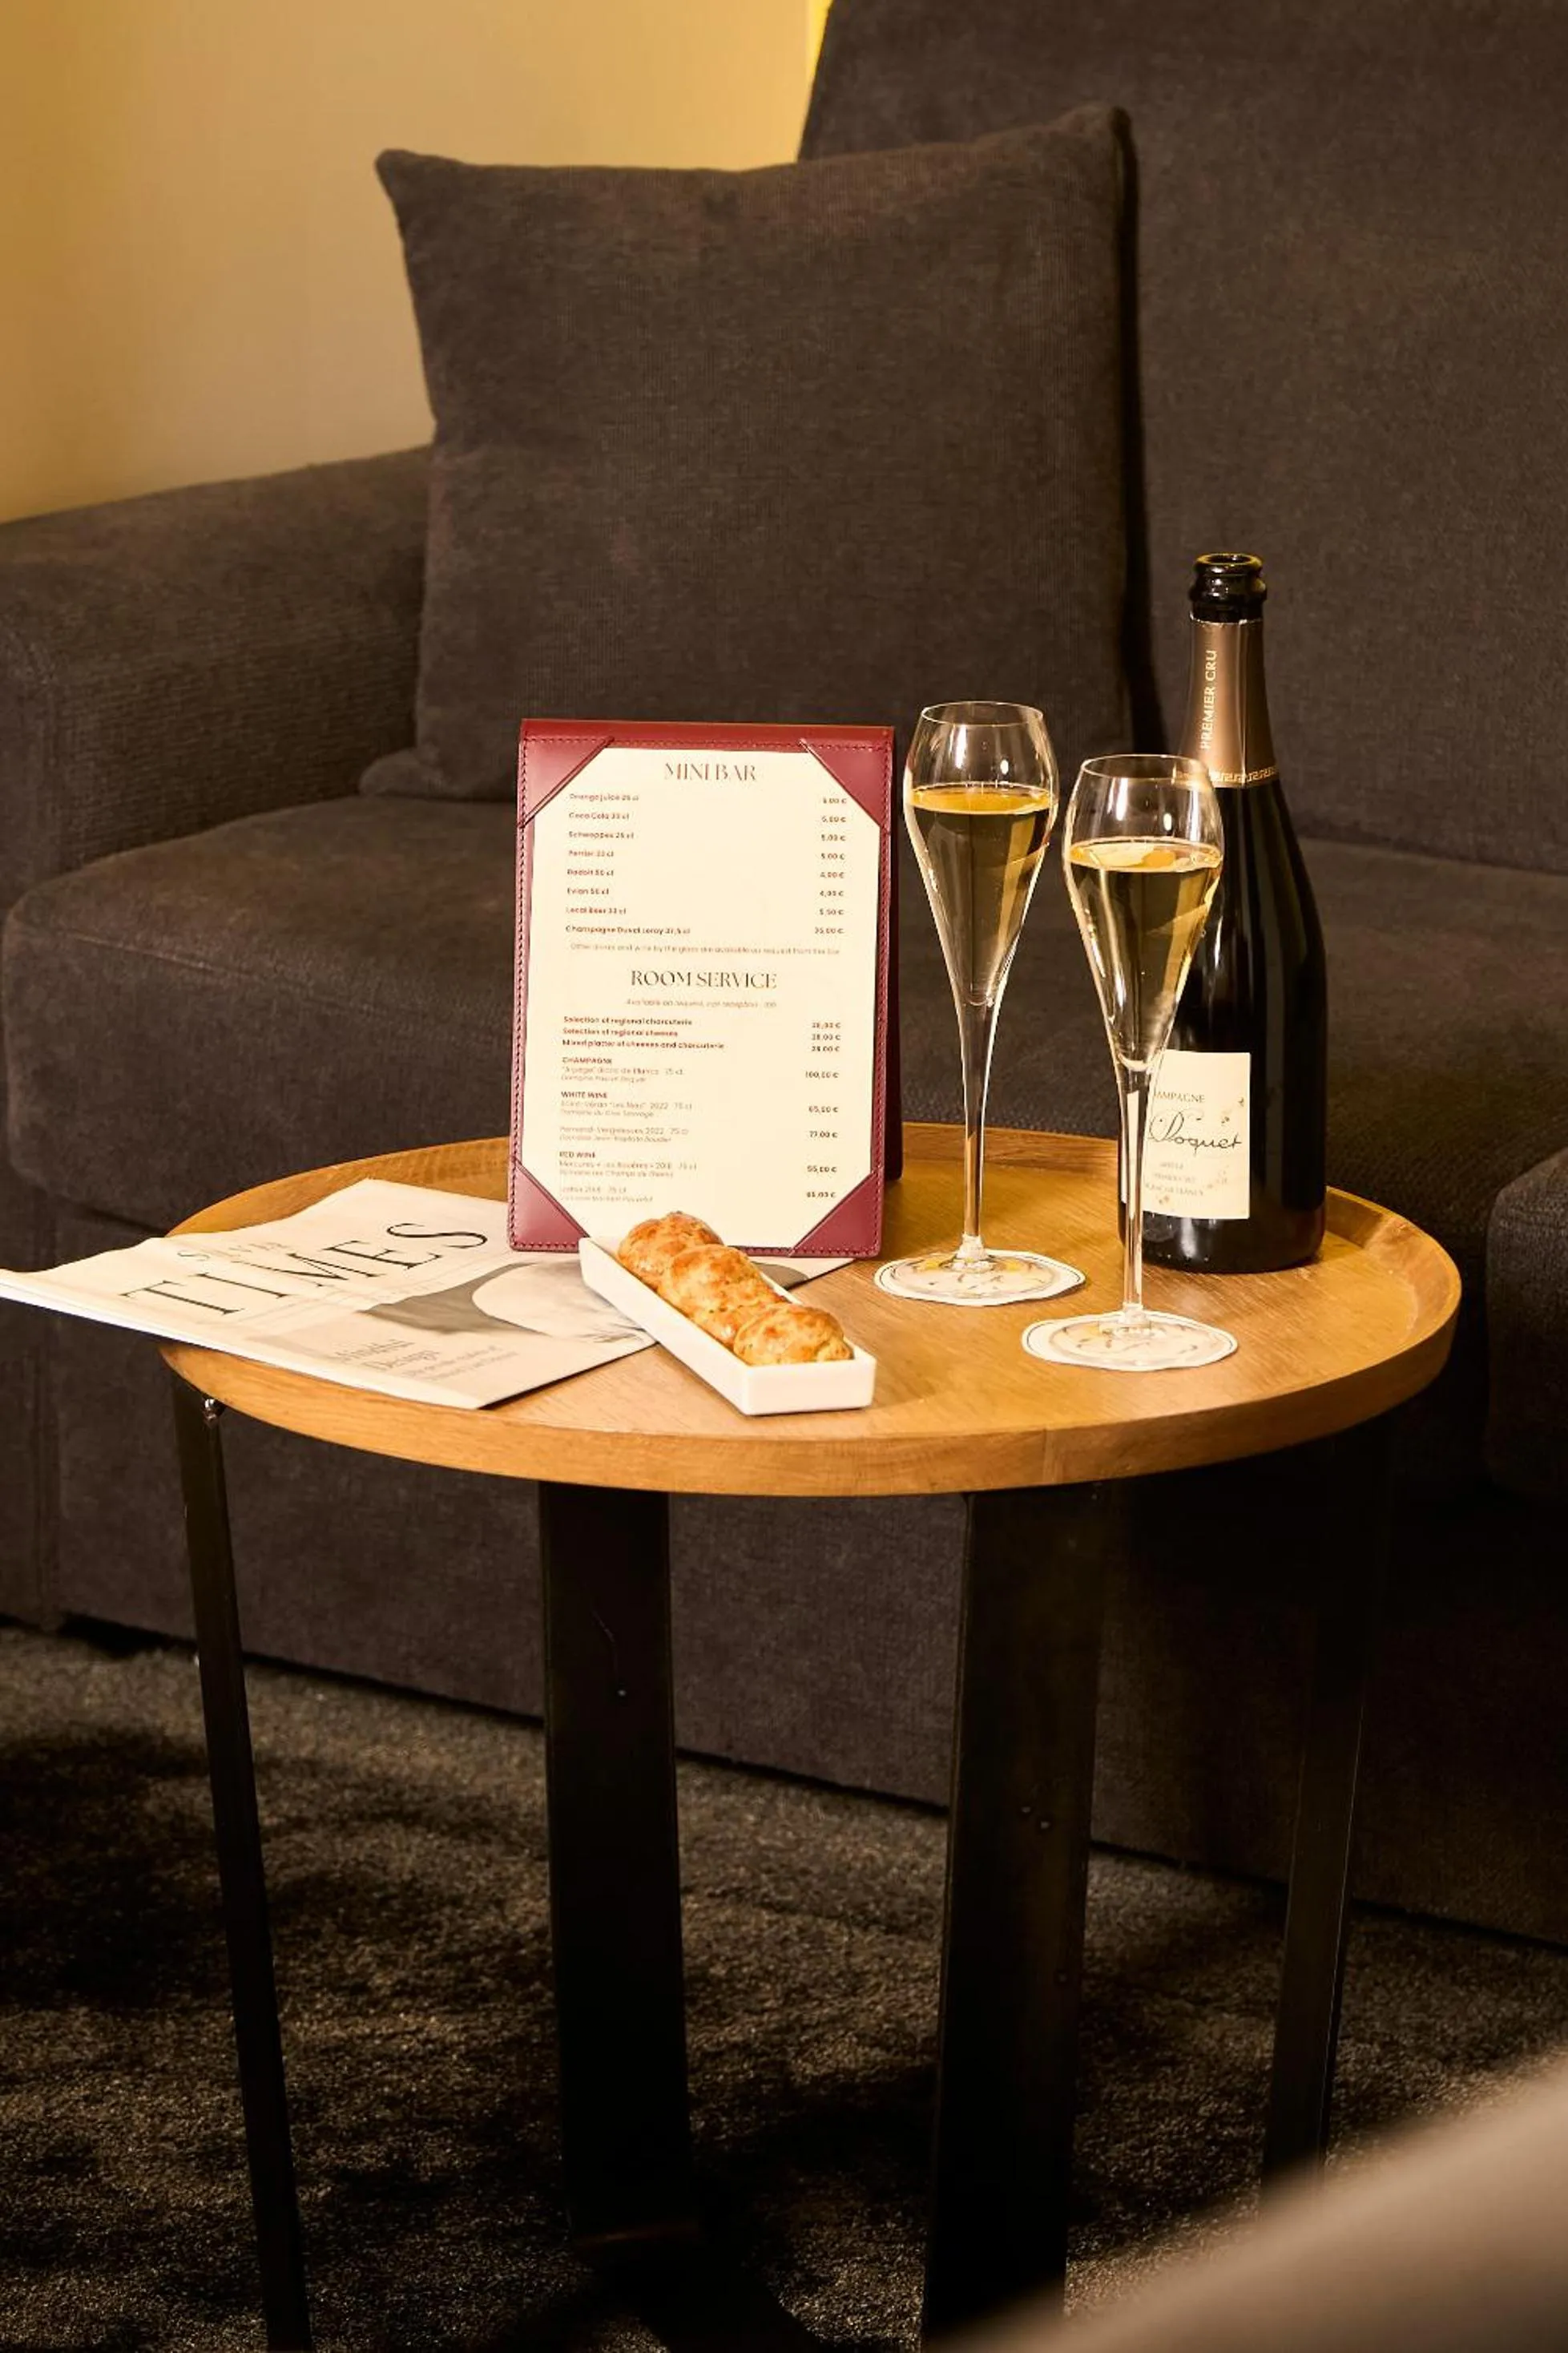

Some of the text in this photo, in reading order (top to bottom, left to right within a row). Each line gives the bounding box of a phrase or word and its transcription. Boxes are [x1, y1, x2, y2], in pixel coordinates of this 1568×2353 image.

[1200, 650, 1217, 749] PREMIER CRU
[665, 763, 756, 781] MINI BAR
[566, 926, 615, 934] Champagne
[631, 970, 777, 988] ROOM SERVICE
[1155, 1091, 1205, 1103] AMPAGNE
[118, 1222, 488, 1316] TIMES
